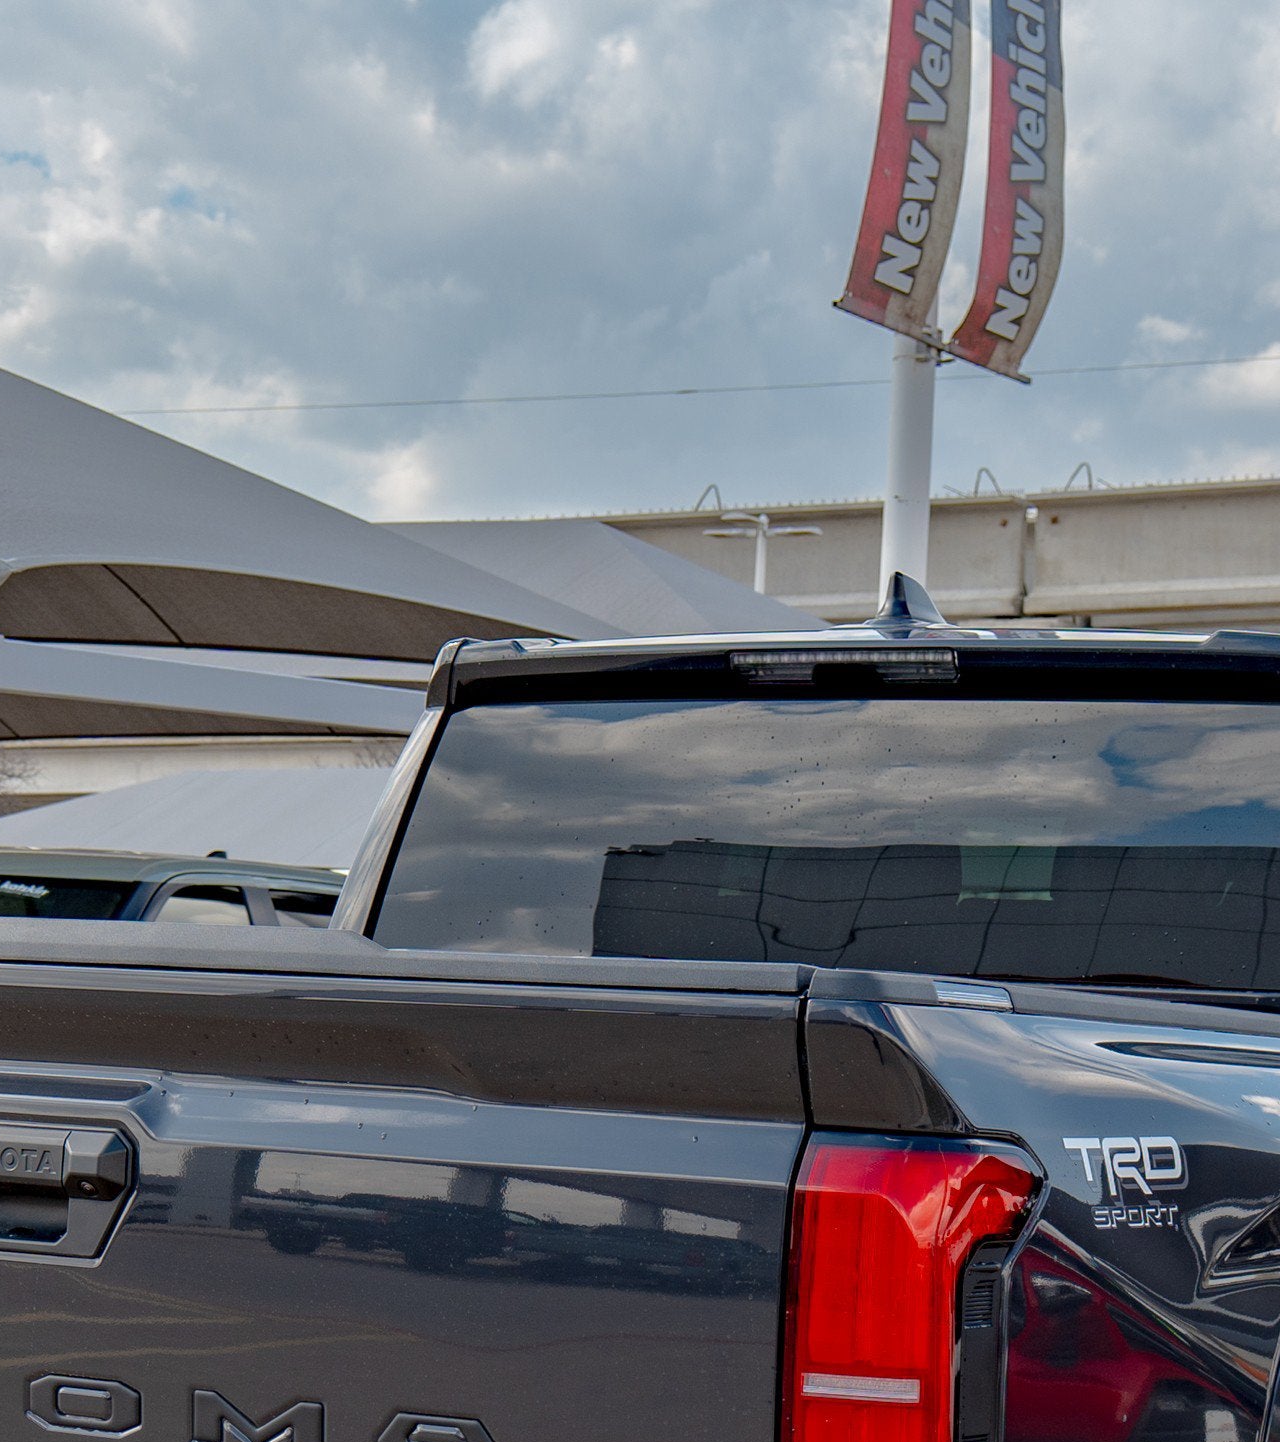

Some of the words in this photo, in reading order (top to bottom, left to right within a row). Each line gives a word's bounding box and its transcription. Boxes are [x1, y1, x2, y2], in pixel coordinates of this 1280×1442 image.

[906, 0, 955, 123] Veh
[1006, 0, 1048, 182] Vehicl
[873, 138, 941, 295] New
[984, 198, 1045, 341] New
[1062, 1136, 1183, 1196] TRD
[1093, 1204, 1179, 1230] SPORT
